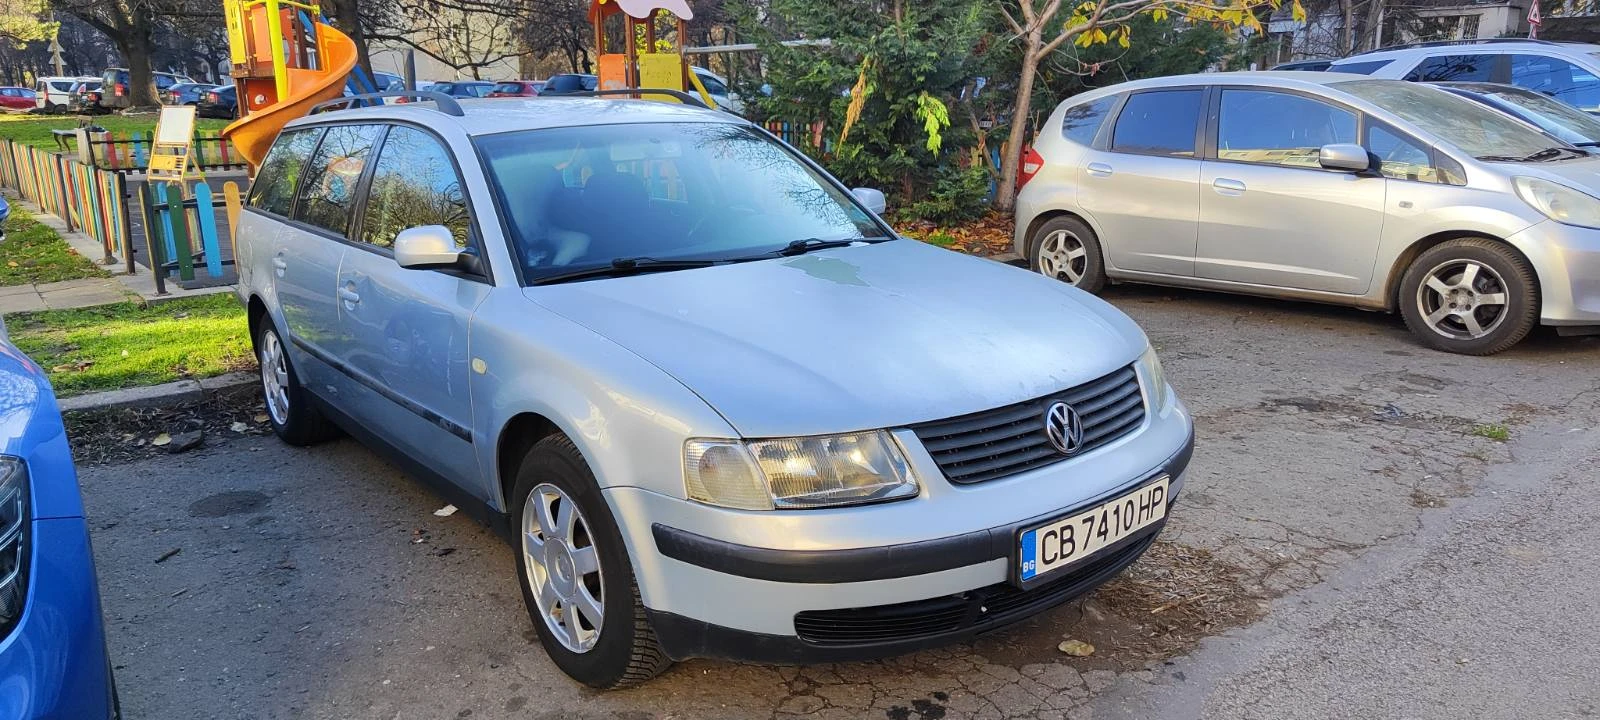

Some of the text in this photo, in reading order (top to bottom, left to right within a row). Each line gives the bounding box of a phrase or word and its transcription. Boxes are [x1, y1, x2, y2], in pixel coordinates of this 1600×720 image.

[1047, 402, 1083, 454] VW
[1041, 485, 1164, 566] CB 7410 HP
[1023, 559, 1035, 573] BG
